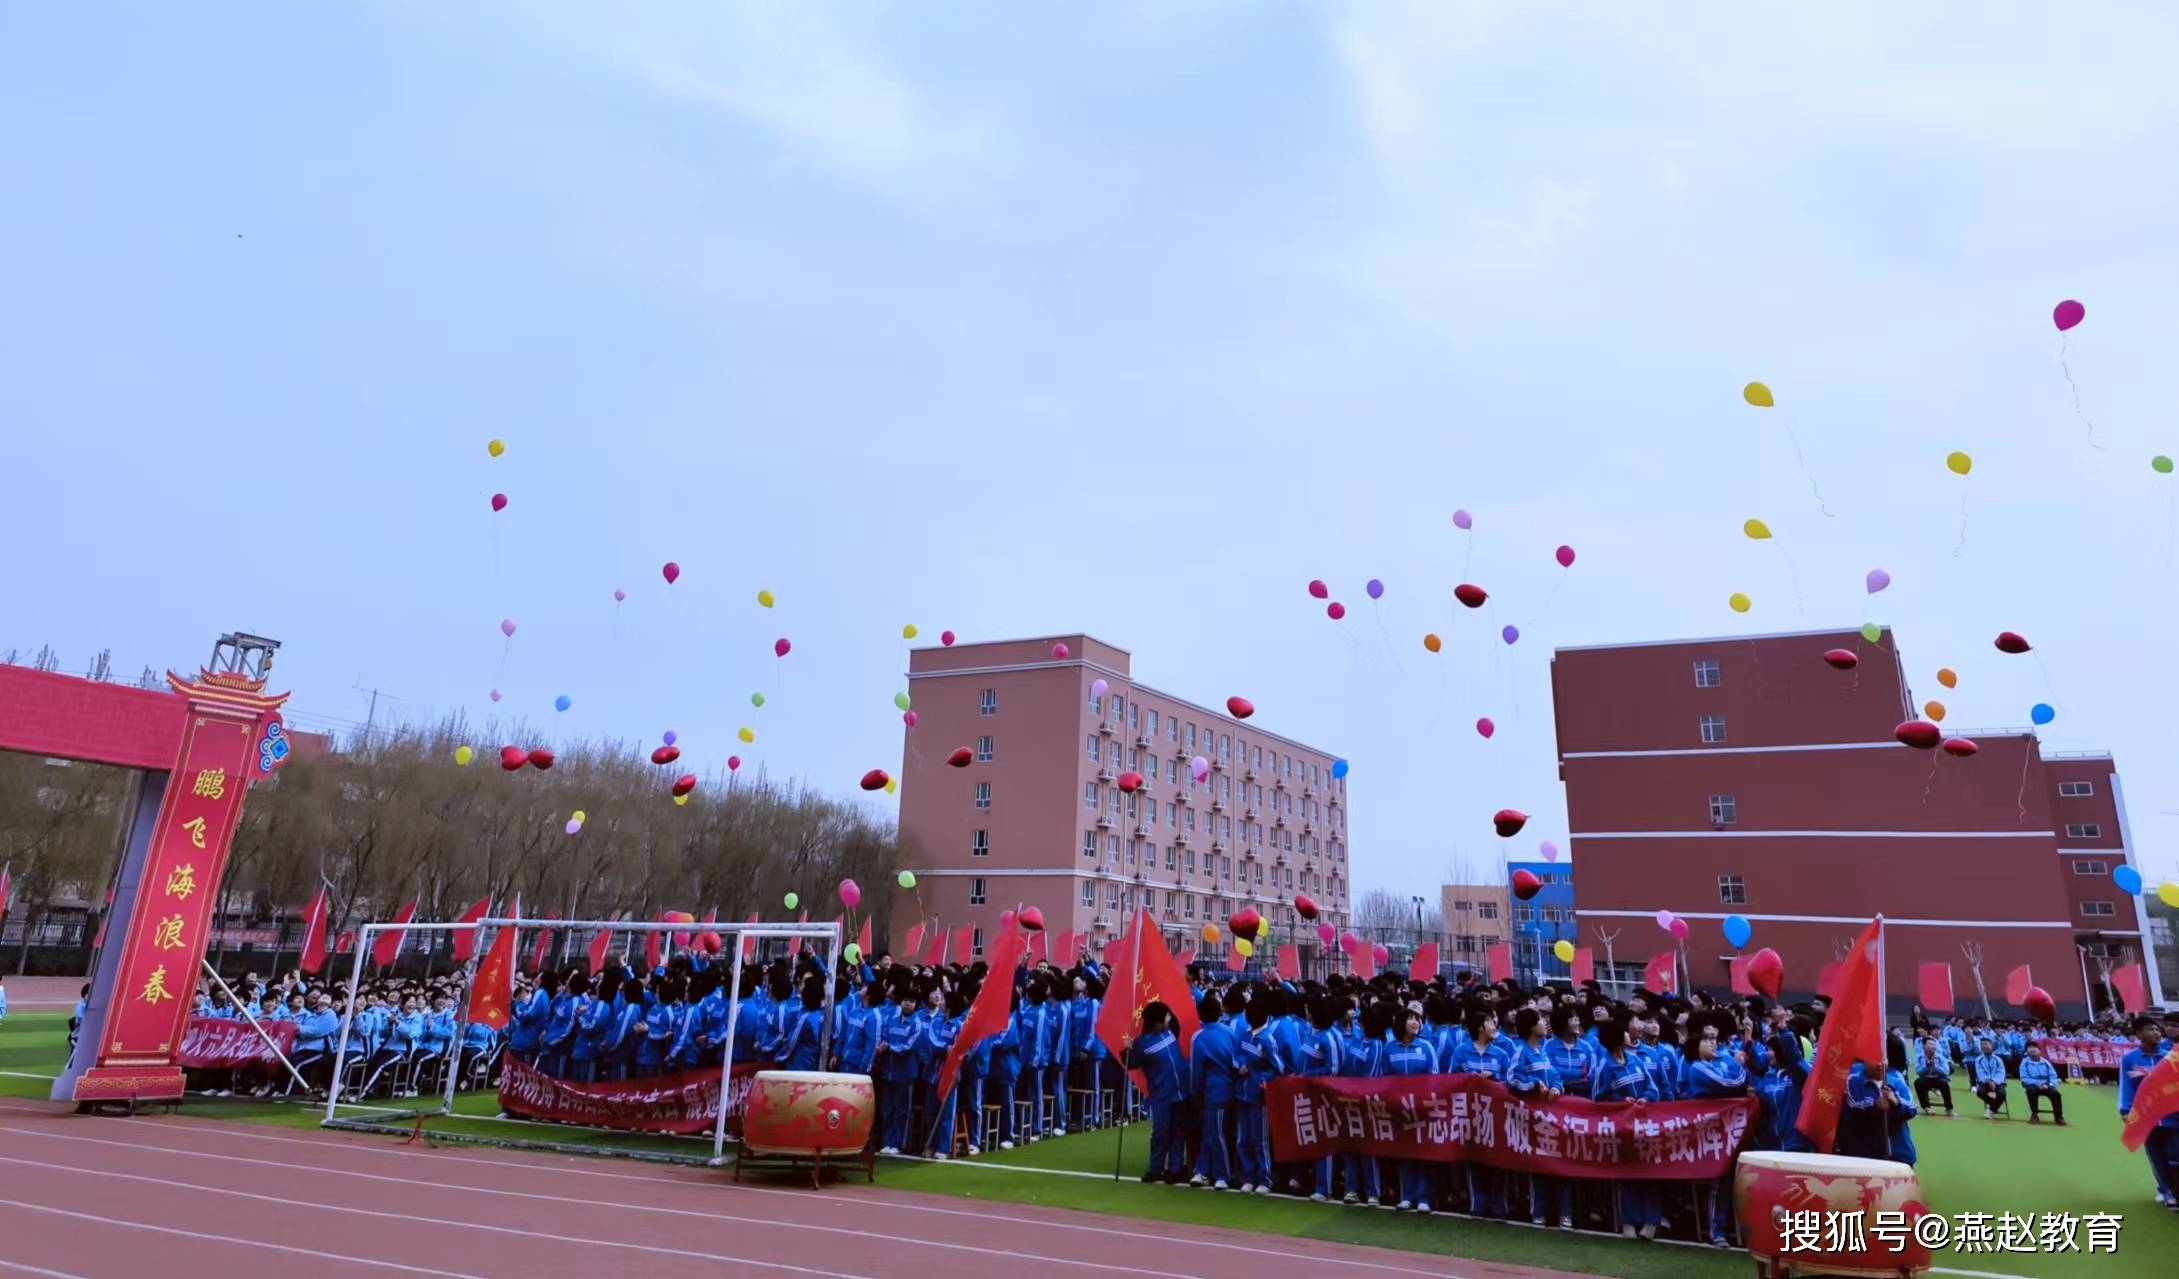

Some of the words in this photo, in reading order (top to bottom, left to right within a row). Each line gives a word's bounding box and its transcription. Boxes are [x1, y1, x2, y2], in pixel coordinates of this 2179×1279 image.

[137, 768, 226, 1004] 鹏飞海浪春
[1293, 1092, 1395, 1146] 信心百倍
[1402, 1092, 1495, 1148] 斗志昂扬
[1504, 1099, 1622, 1163] 破釜沉舟
